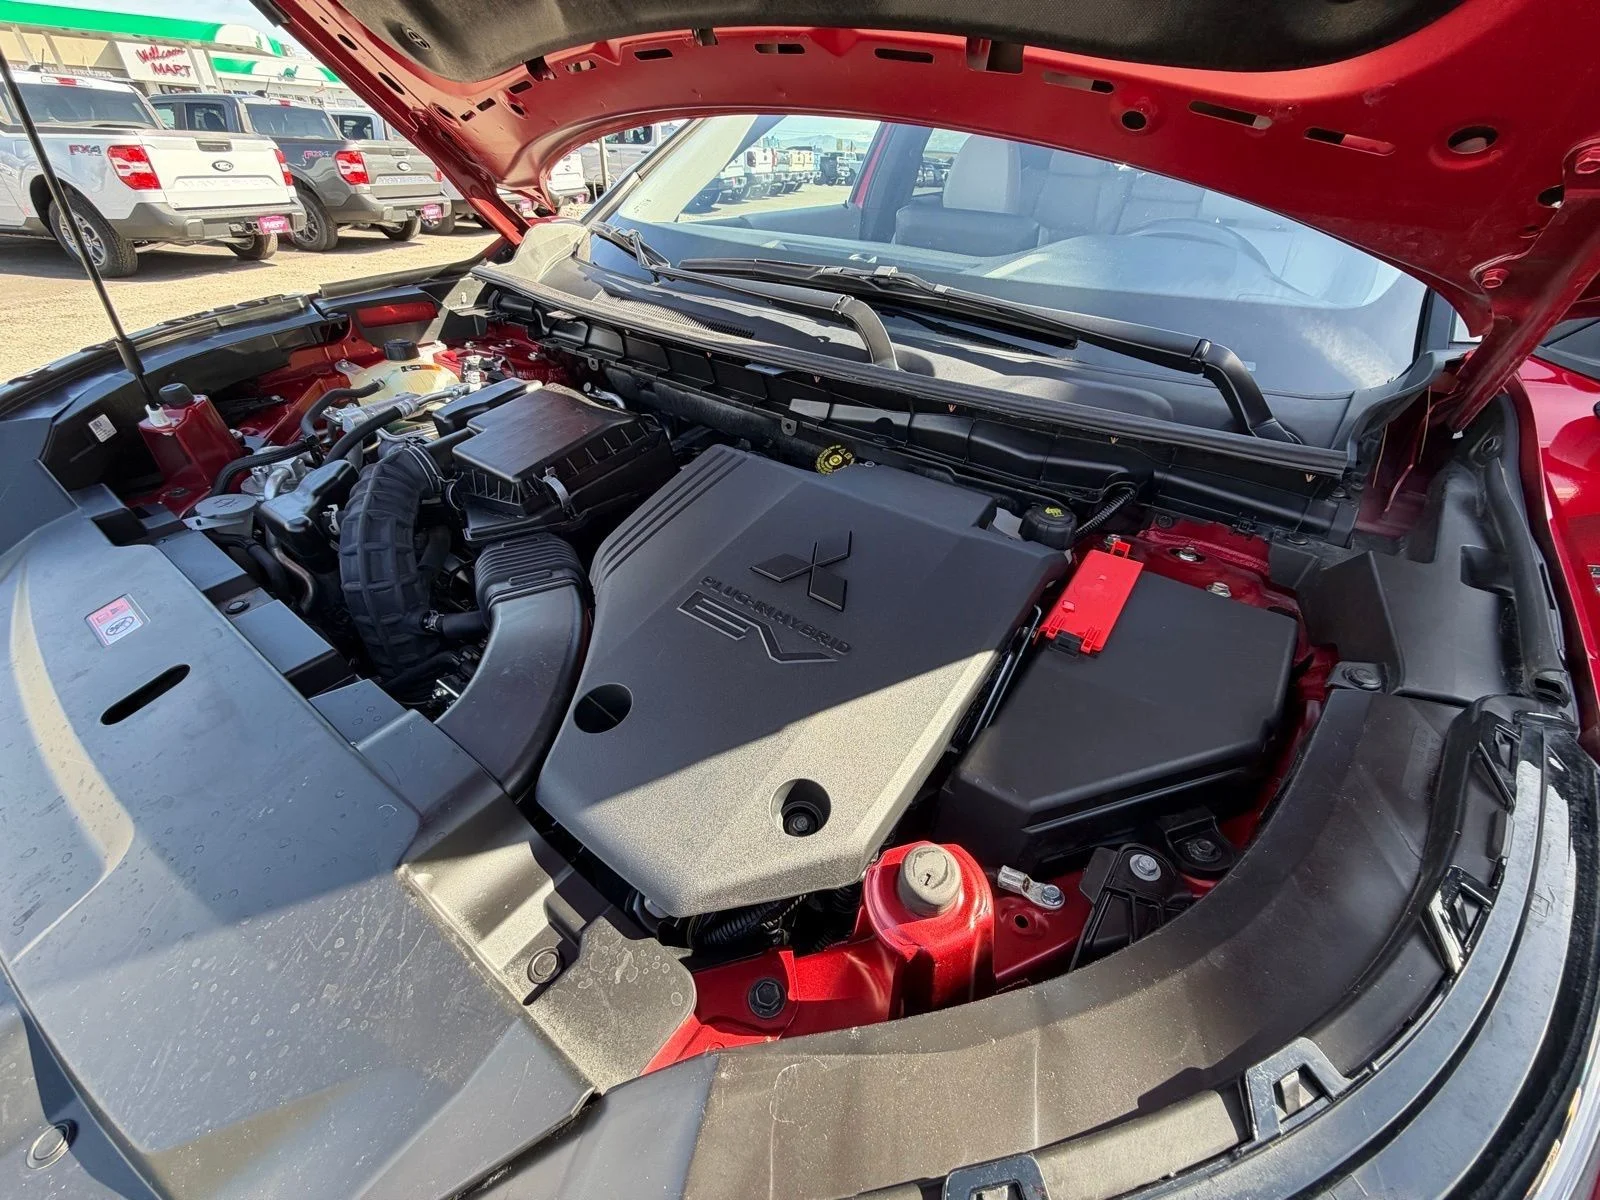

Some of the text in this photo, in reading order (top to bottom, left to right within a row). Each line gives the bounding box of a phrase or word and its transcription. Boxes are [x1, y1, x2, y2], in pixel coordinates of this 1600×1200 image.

[151, 62, 191, 78] MART
[69, 144, 102, 155] FX4
[677, 589, 838, 664] EV
